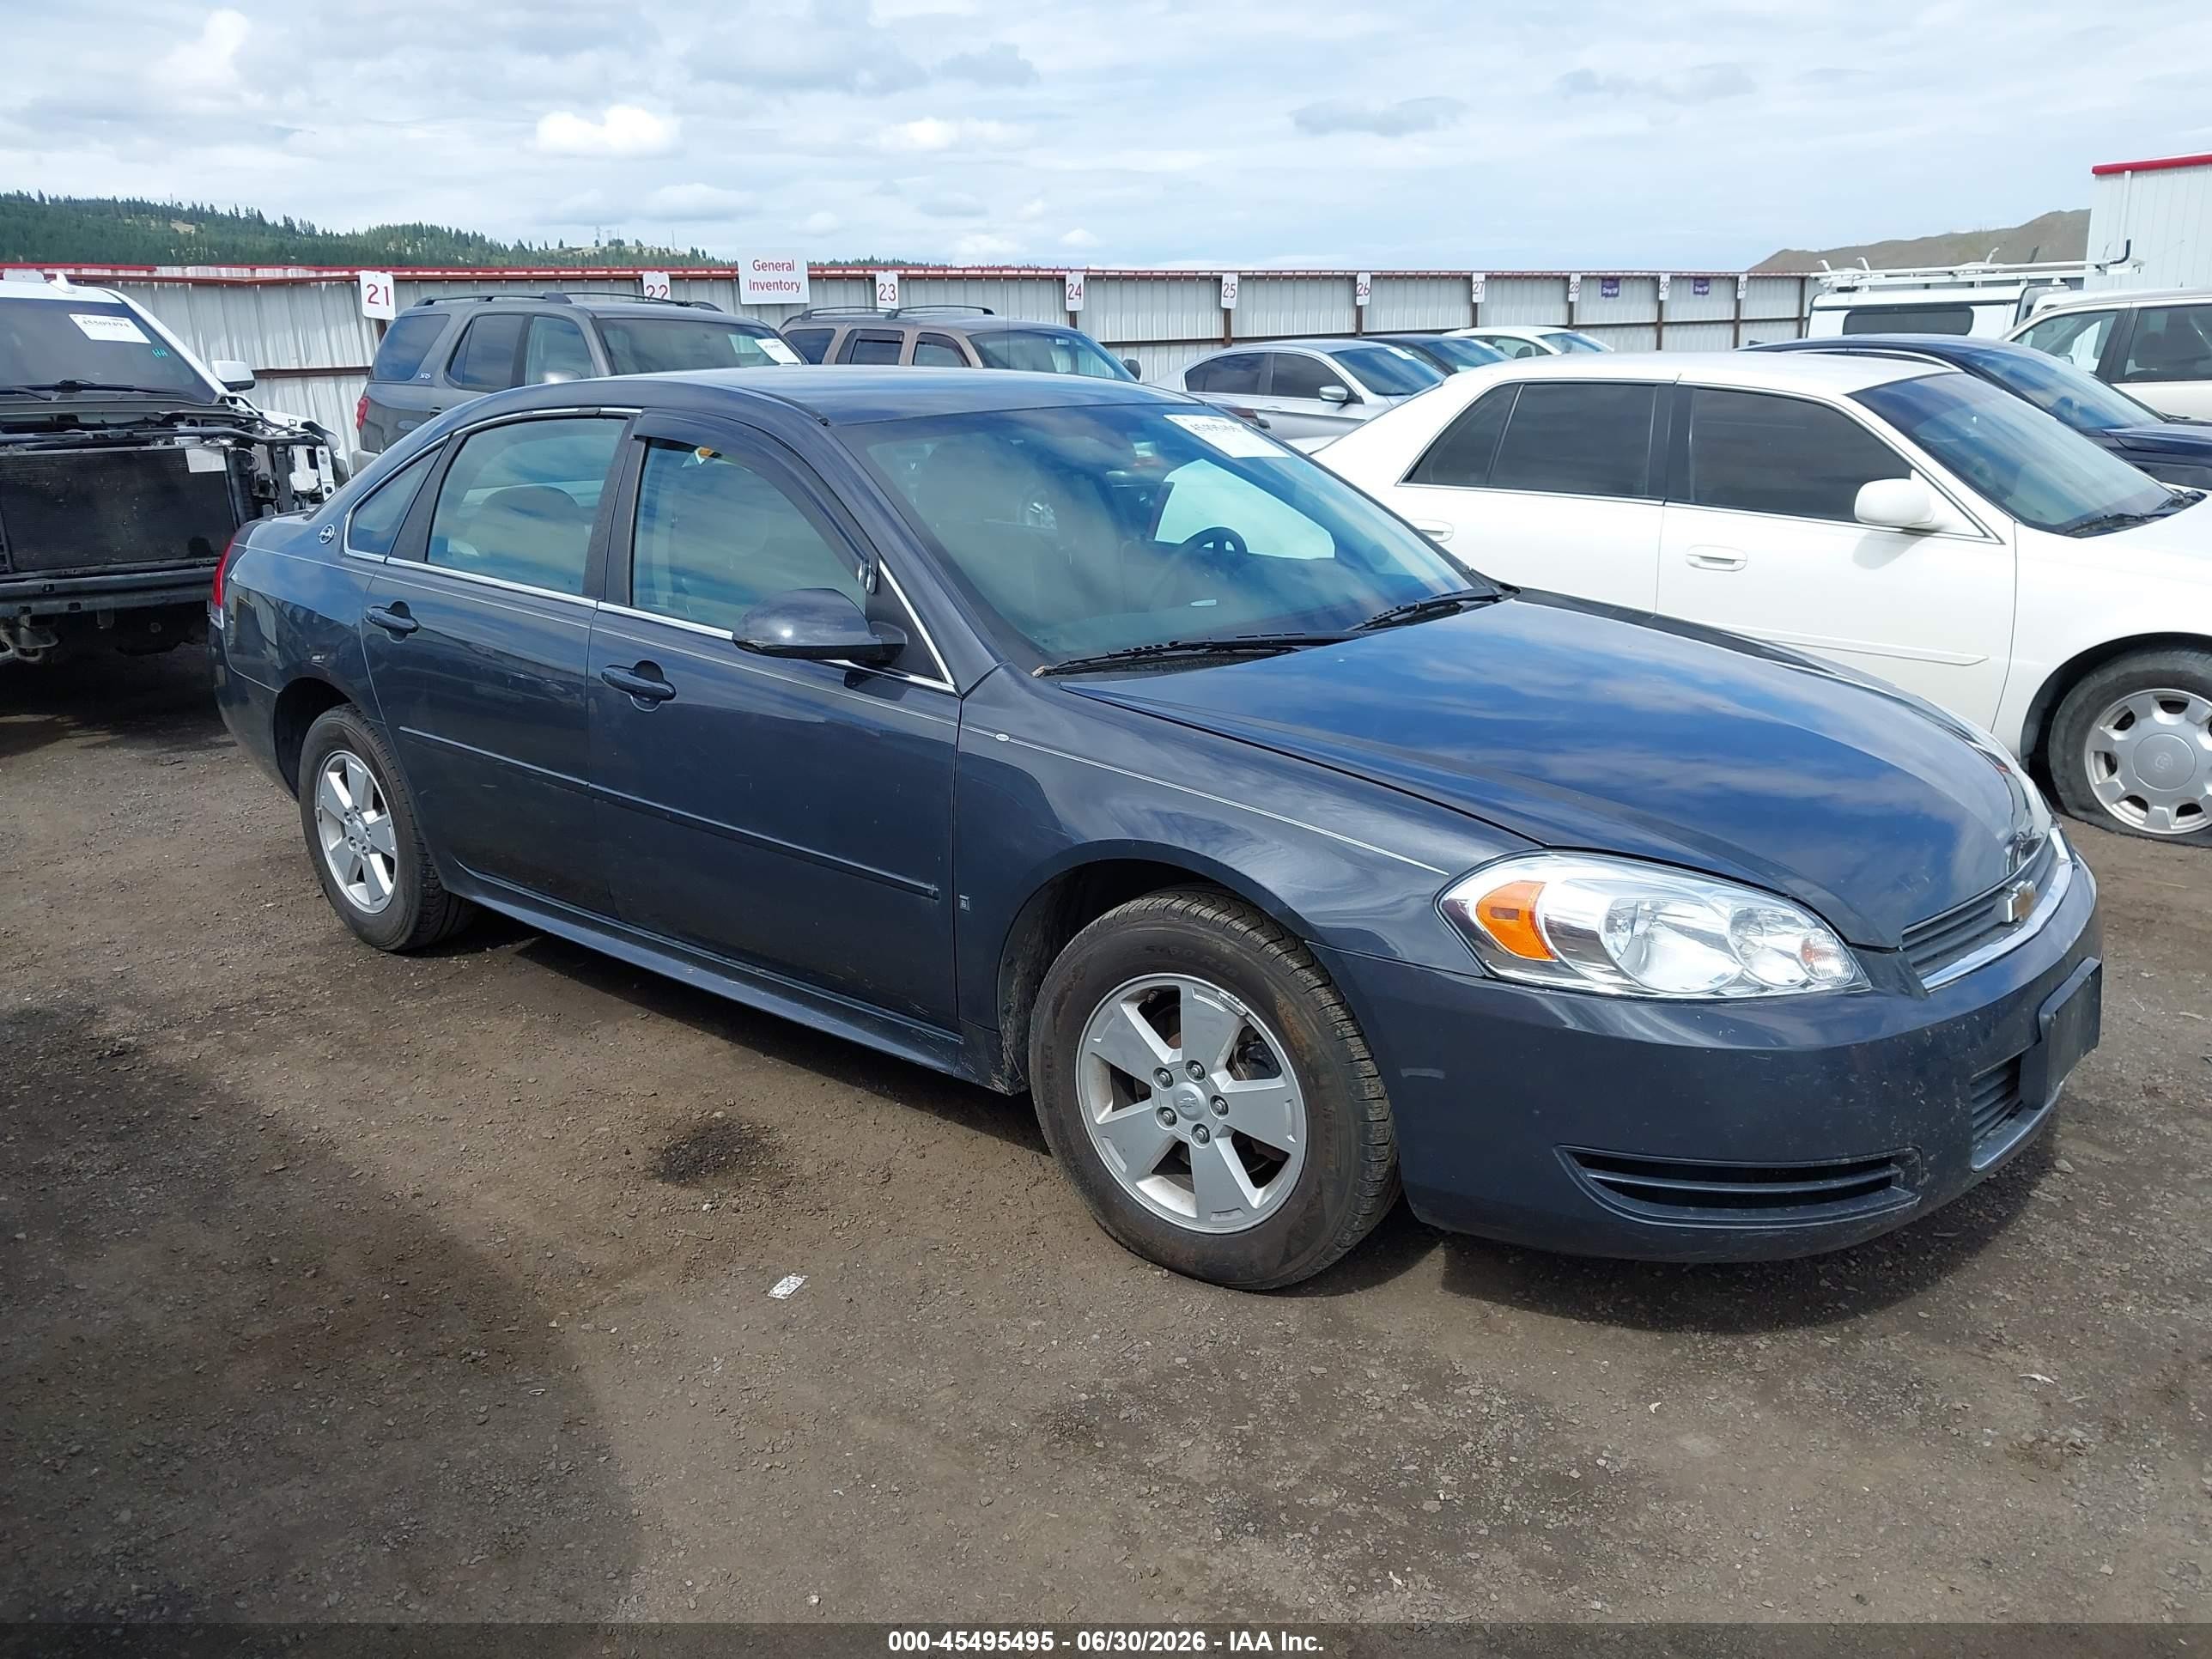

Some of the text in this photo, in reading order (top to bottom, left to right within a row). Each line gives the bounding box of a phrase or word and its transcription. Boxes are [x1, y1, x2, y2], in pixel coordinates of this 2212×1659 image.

[752, 259, 795, 271] General
[749, 279, 801, 294] Inventory
[878, 283, 896, 301] 23
[1067, 283, 1082, 301] 24
[1223, 283, 1237, 299] 25
[1356, 283, 1370, 296] 26
[1472, 281, 1486, 295] 27
[366, 283, 390, 306] 21
